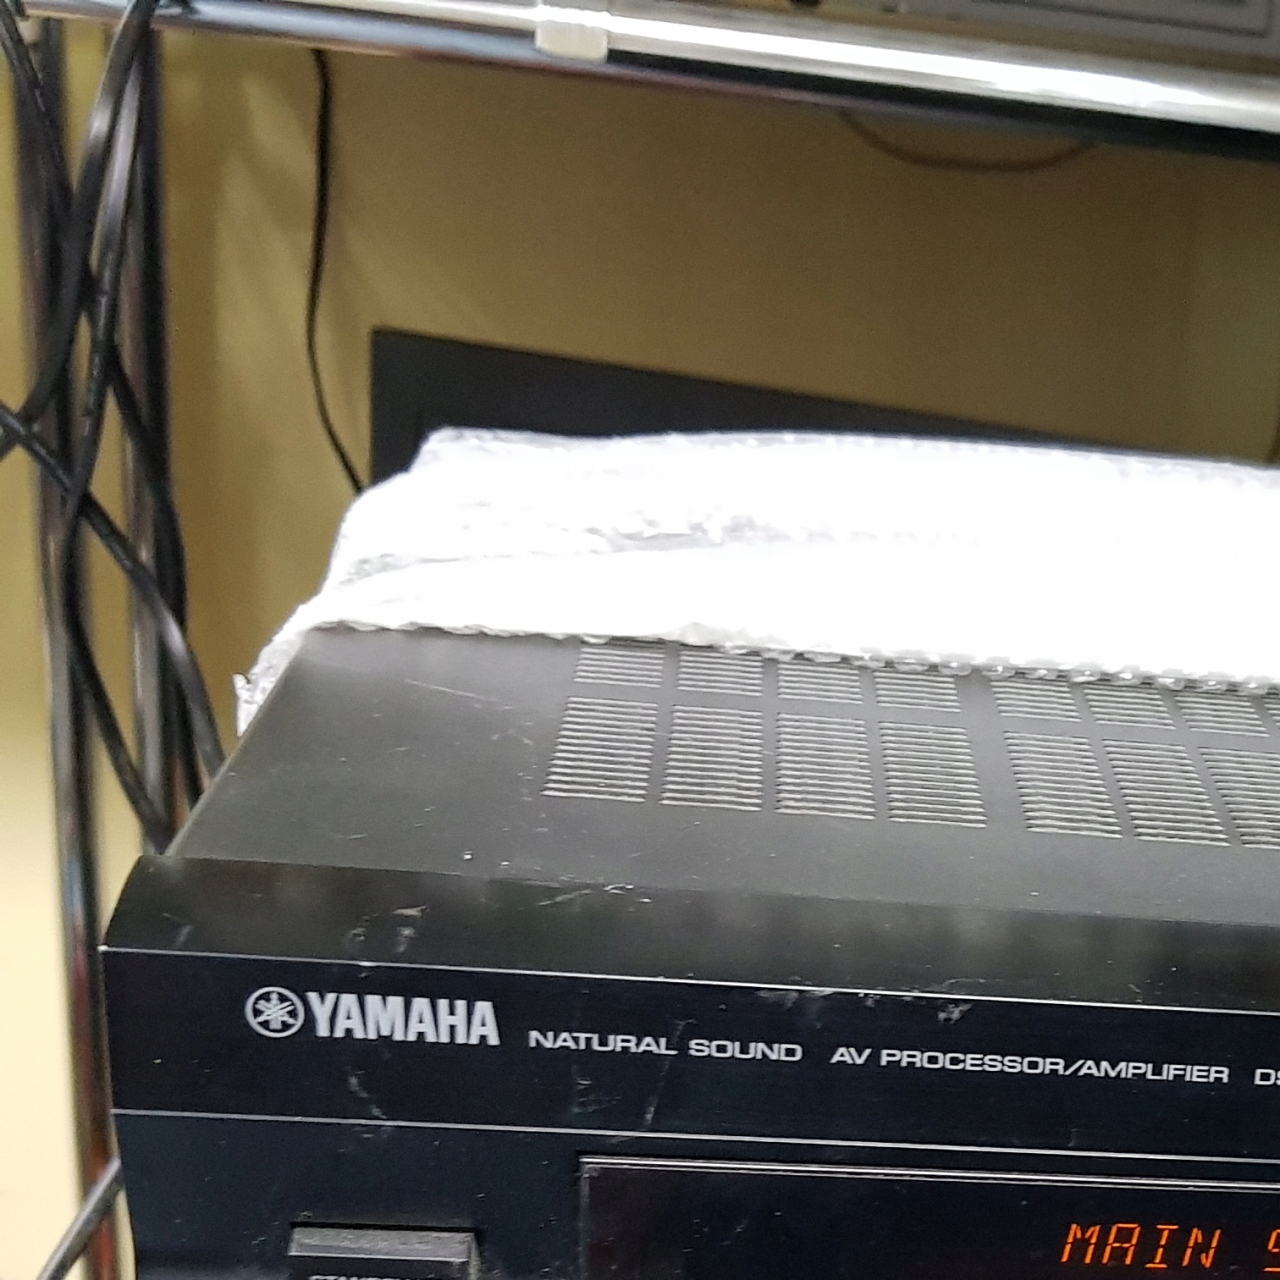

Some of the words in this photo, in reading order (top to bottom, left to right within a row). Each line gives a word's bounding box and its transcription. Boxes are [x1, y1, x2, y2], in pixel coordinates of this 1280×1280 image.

[306, 990, 500, 1048] YAMAHA
[527, 1029, 678, 1056] NATURAL
[687, 1038, 804, 1064] SOUND
[830, 1046, 873, 1066] AV
[879, 1048, 1230, 1085] PROCESSOR/AMPLIFIER
[1060, 1222, 1223, 1270] MAIN
